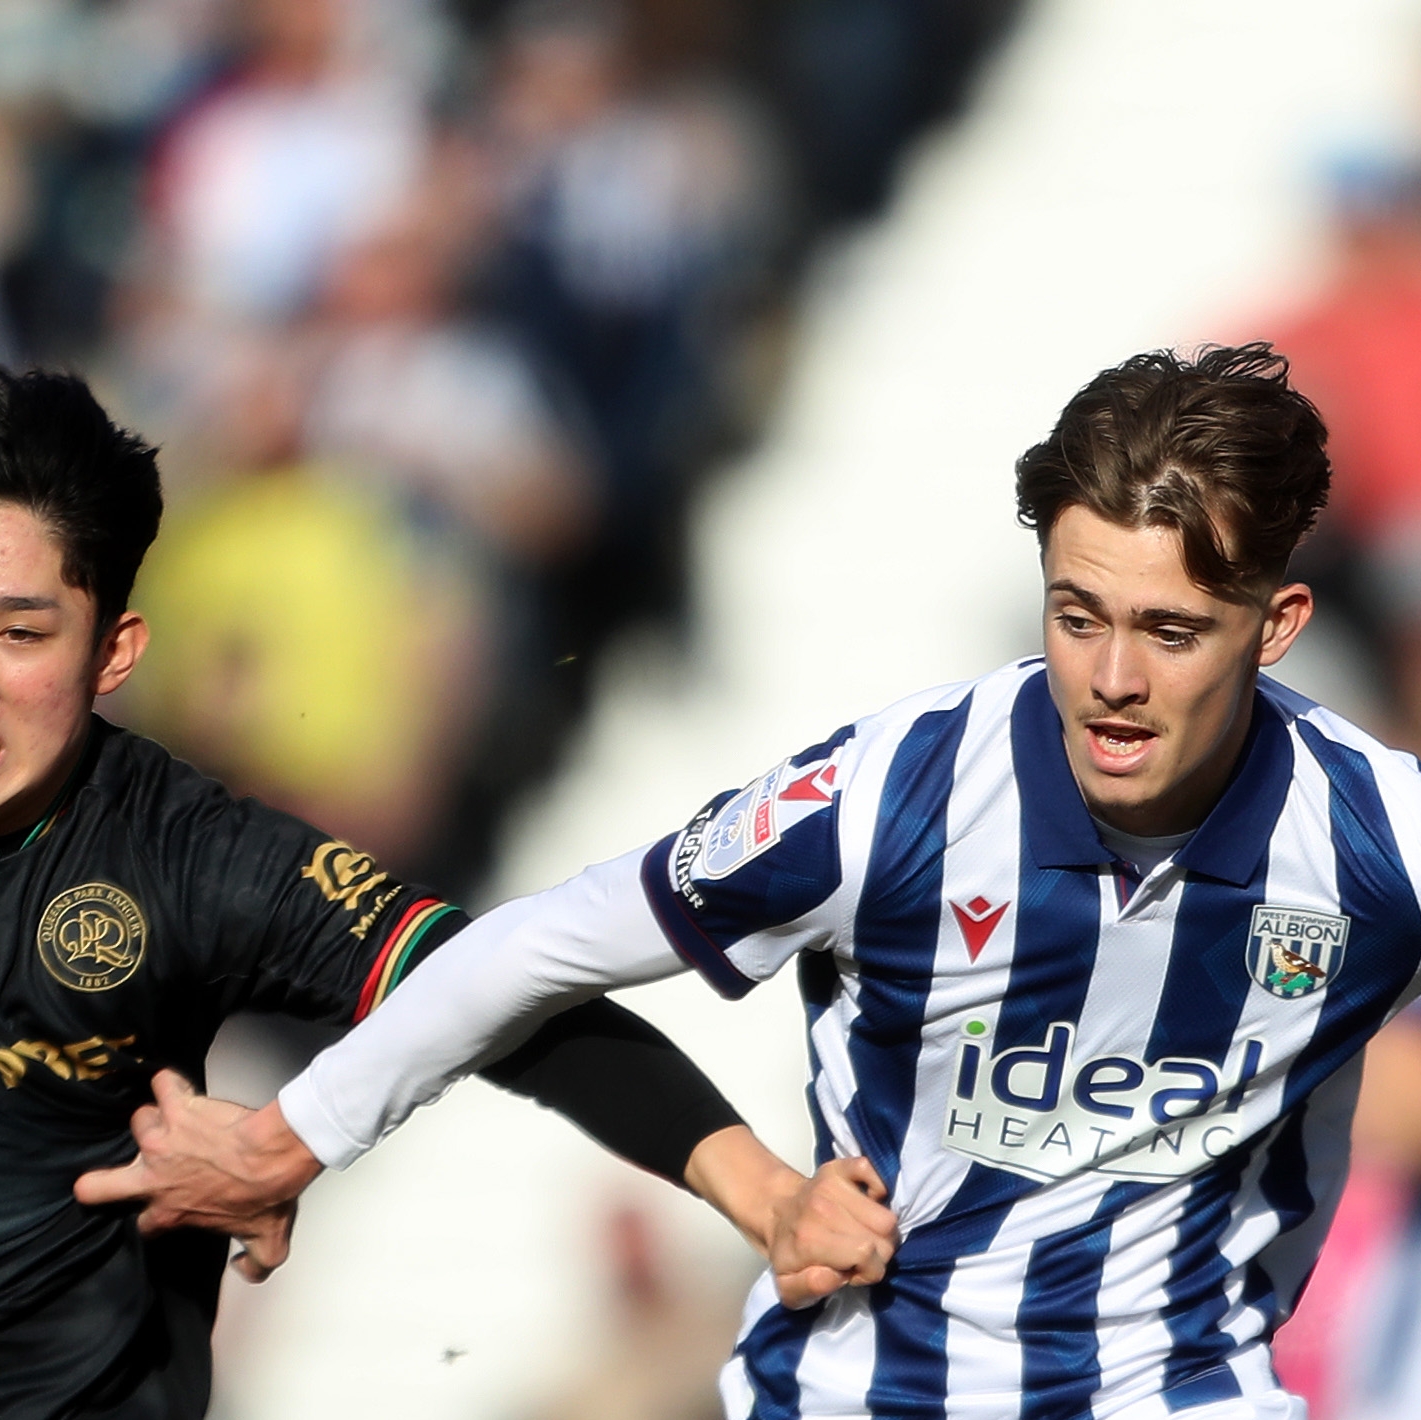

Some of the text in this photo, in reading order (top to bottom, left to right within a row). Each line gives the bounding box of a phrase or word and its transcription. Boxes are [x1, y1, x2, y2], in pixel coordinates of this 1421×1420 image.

[756, 803, 770, 841] bet
[73, 888, 105, 901] PARK
[1256, 919, 1341, 943] ALBION
[1259, 910, 1343, 928] WEST BROMWICH
[955, 1019, 1264, 1126] ideal
